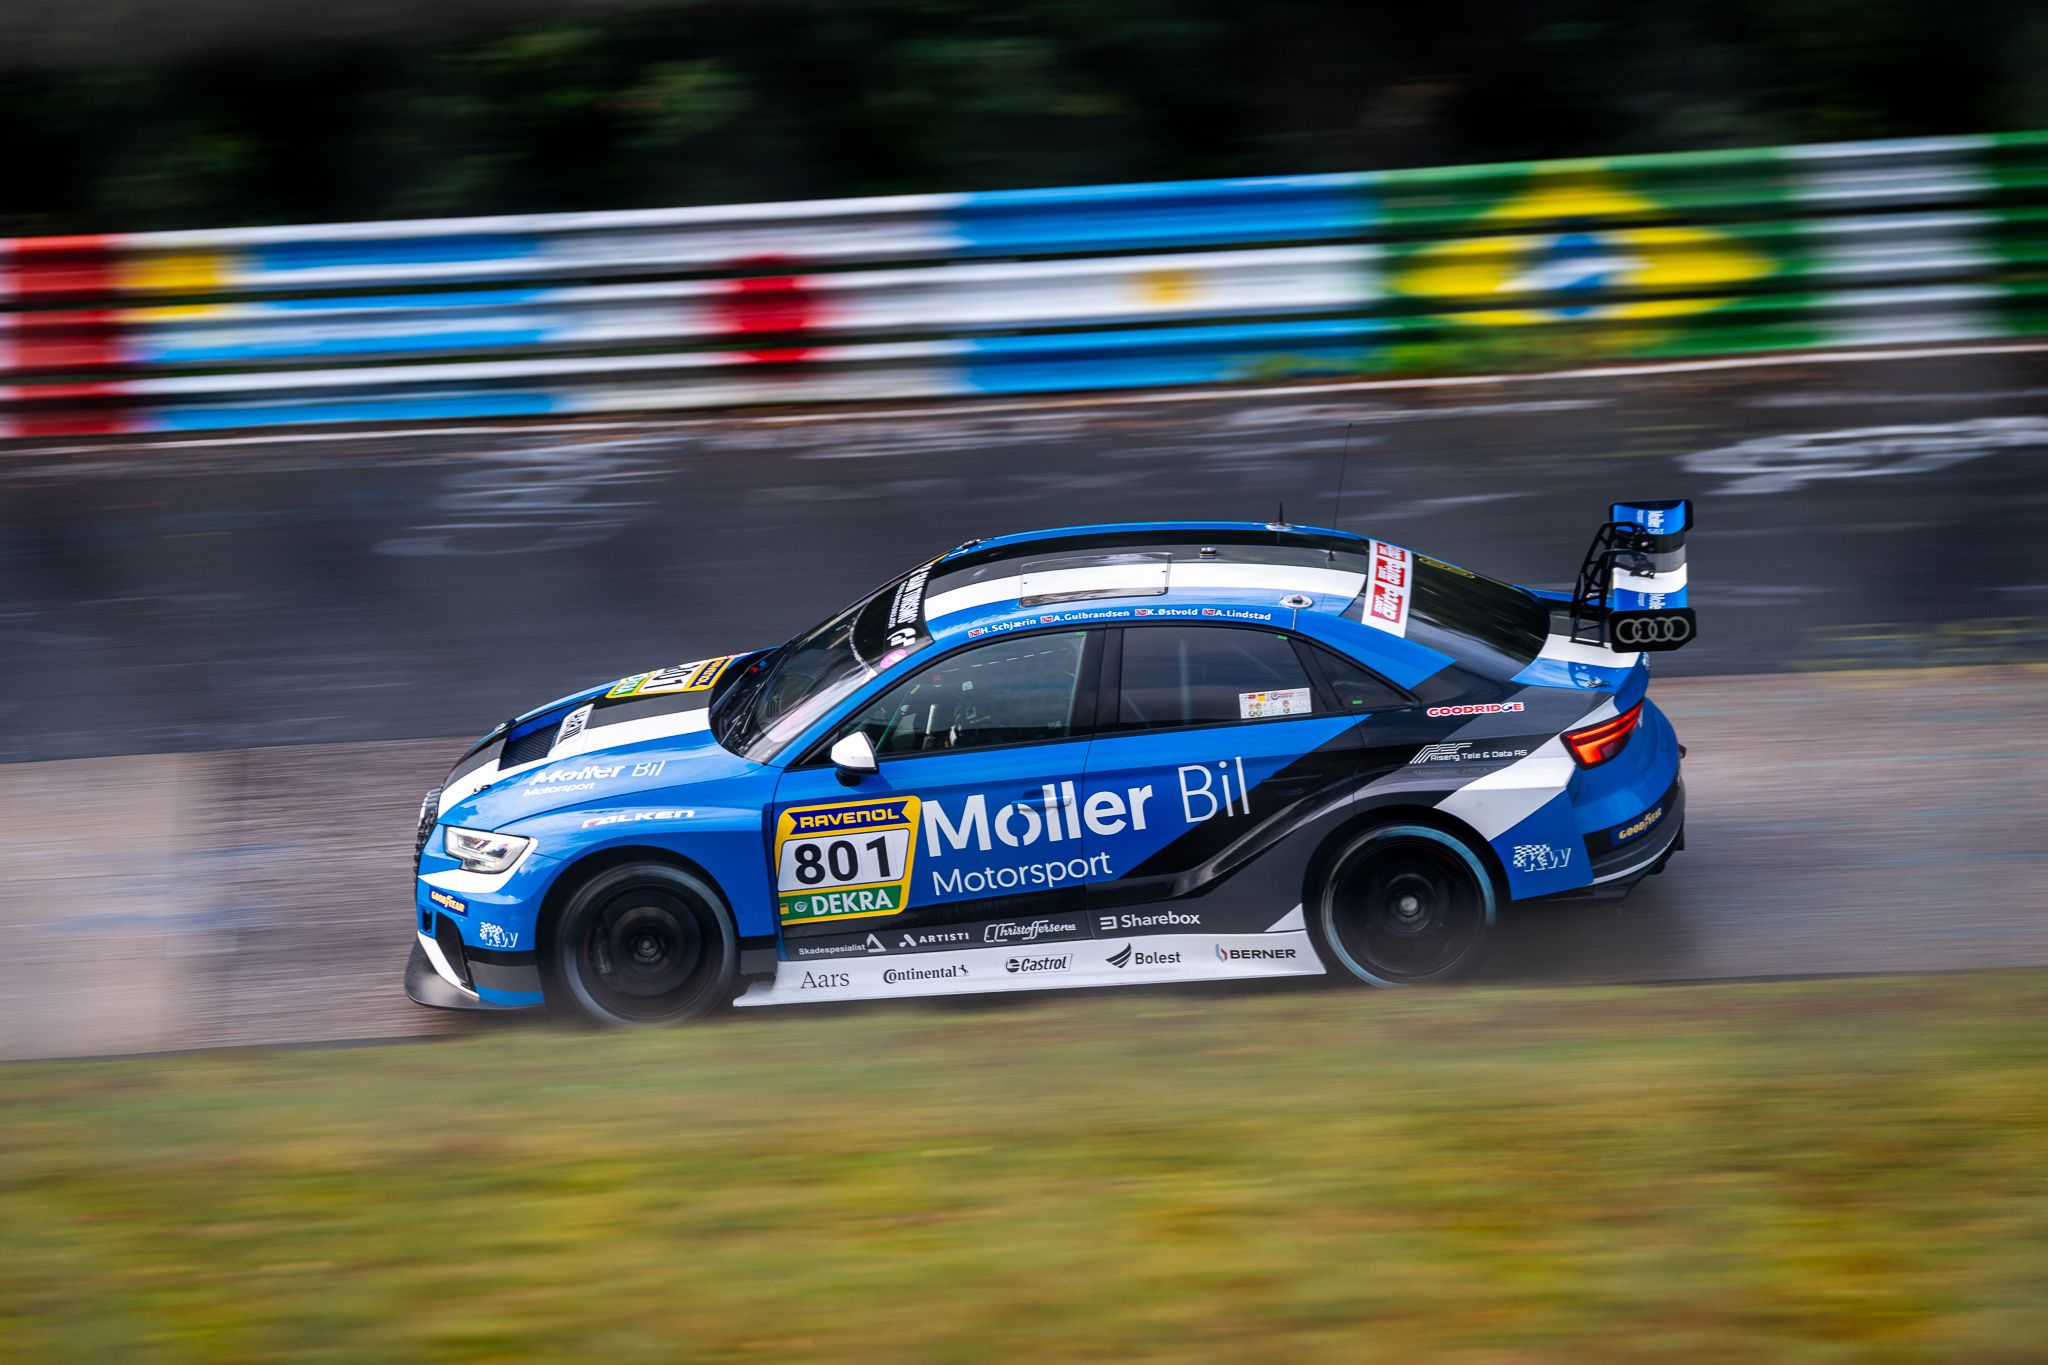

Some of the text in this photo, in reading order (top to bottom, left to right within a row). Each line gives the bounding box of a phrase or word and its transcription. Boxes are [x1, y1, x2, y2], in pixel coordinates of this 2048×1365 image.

[1428, 702, 1523, 717] GOODRIDGE
[1431, 754, 1460, 762] Riseng
[1492, 750, 1513, 758] Data
[631, 761, 666, 777] Bil
[523, 782, 596, 797] Motorsport
[1177, 756, 1250, 823] Bil
[581, 809, 695, 828] FALKEN
[800, 808, 899, 829] RAVENOL
[794, 836, 891, 885] 801
[1521, 846, 1572, 872] KW
[932, 851, 1112, 896] Motorsport
[431, 891, 465, 912] GOODYEAR
[811, 889, 894, 916] DEKRA
[1121, 910, 1200, 927] Sharebox
[484, 927, 519, 948] KW
[919, 932, 970, 943] ARTISTI
[994, 920, 1067, 942] Christoffersen
[799, 944, 866, 956] Skadespesialist
[1135, 951, 1181, 965] Bolest
[1230, 949, 1296, 960] BERNER
[1021, 956, 1067, 972] Castrol
[801, 970, 850, 989] Aars
[883, 965, 957, 985] Continental
